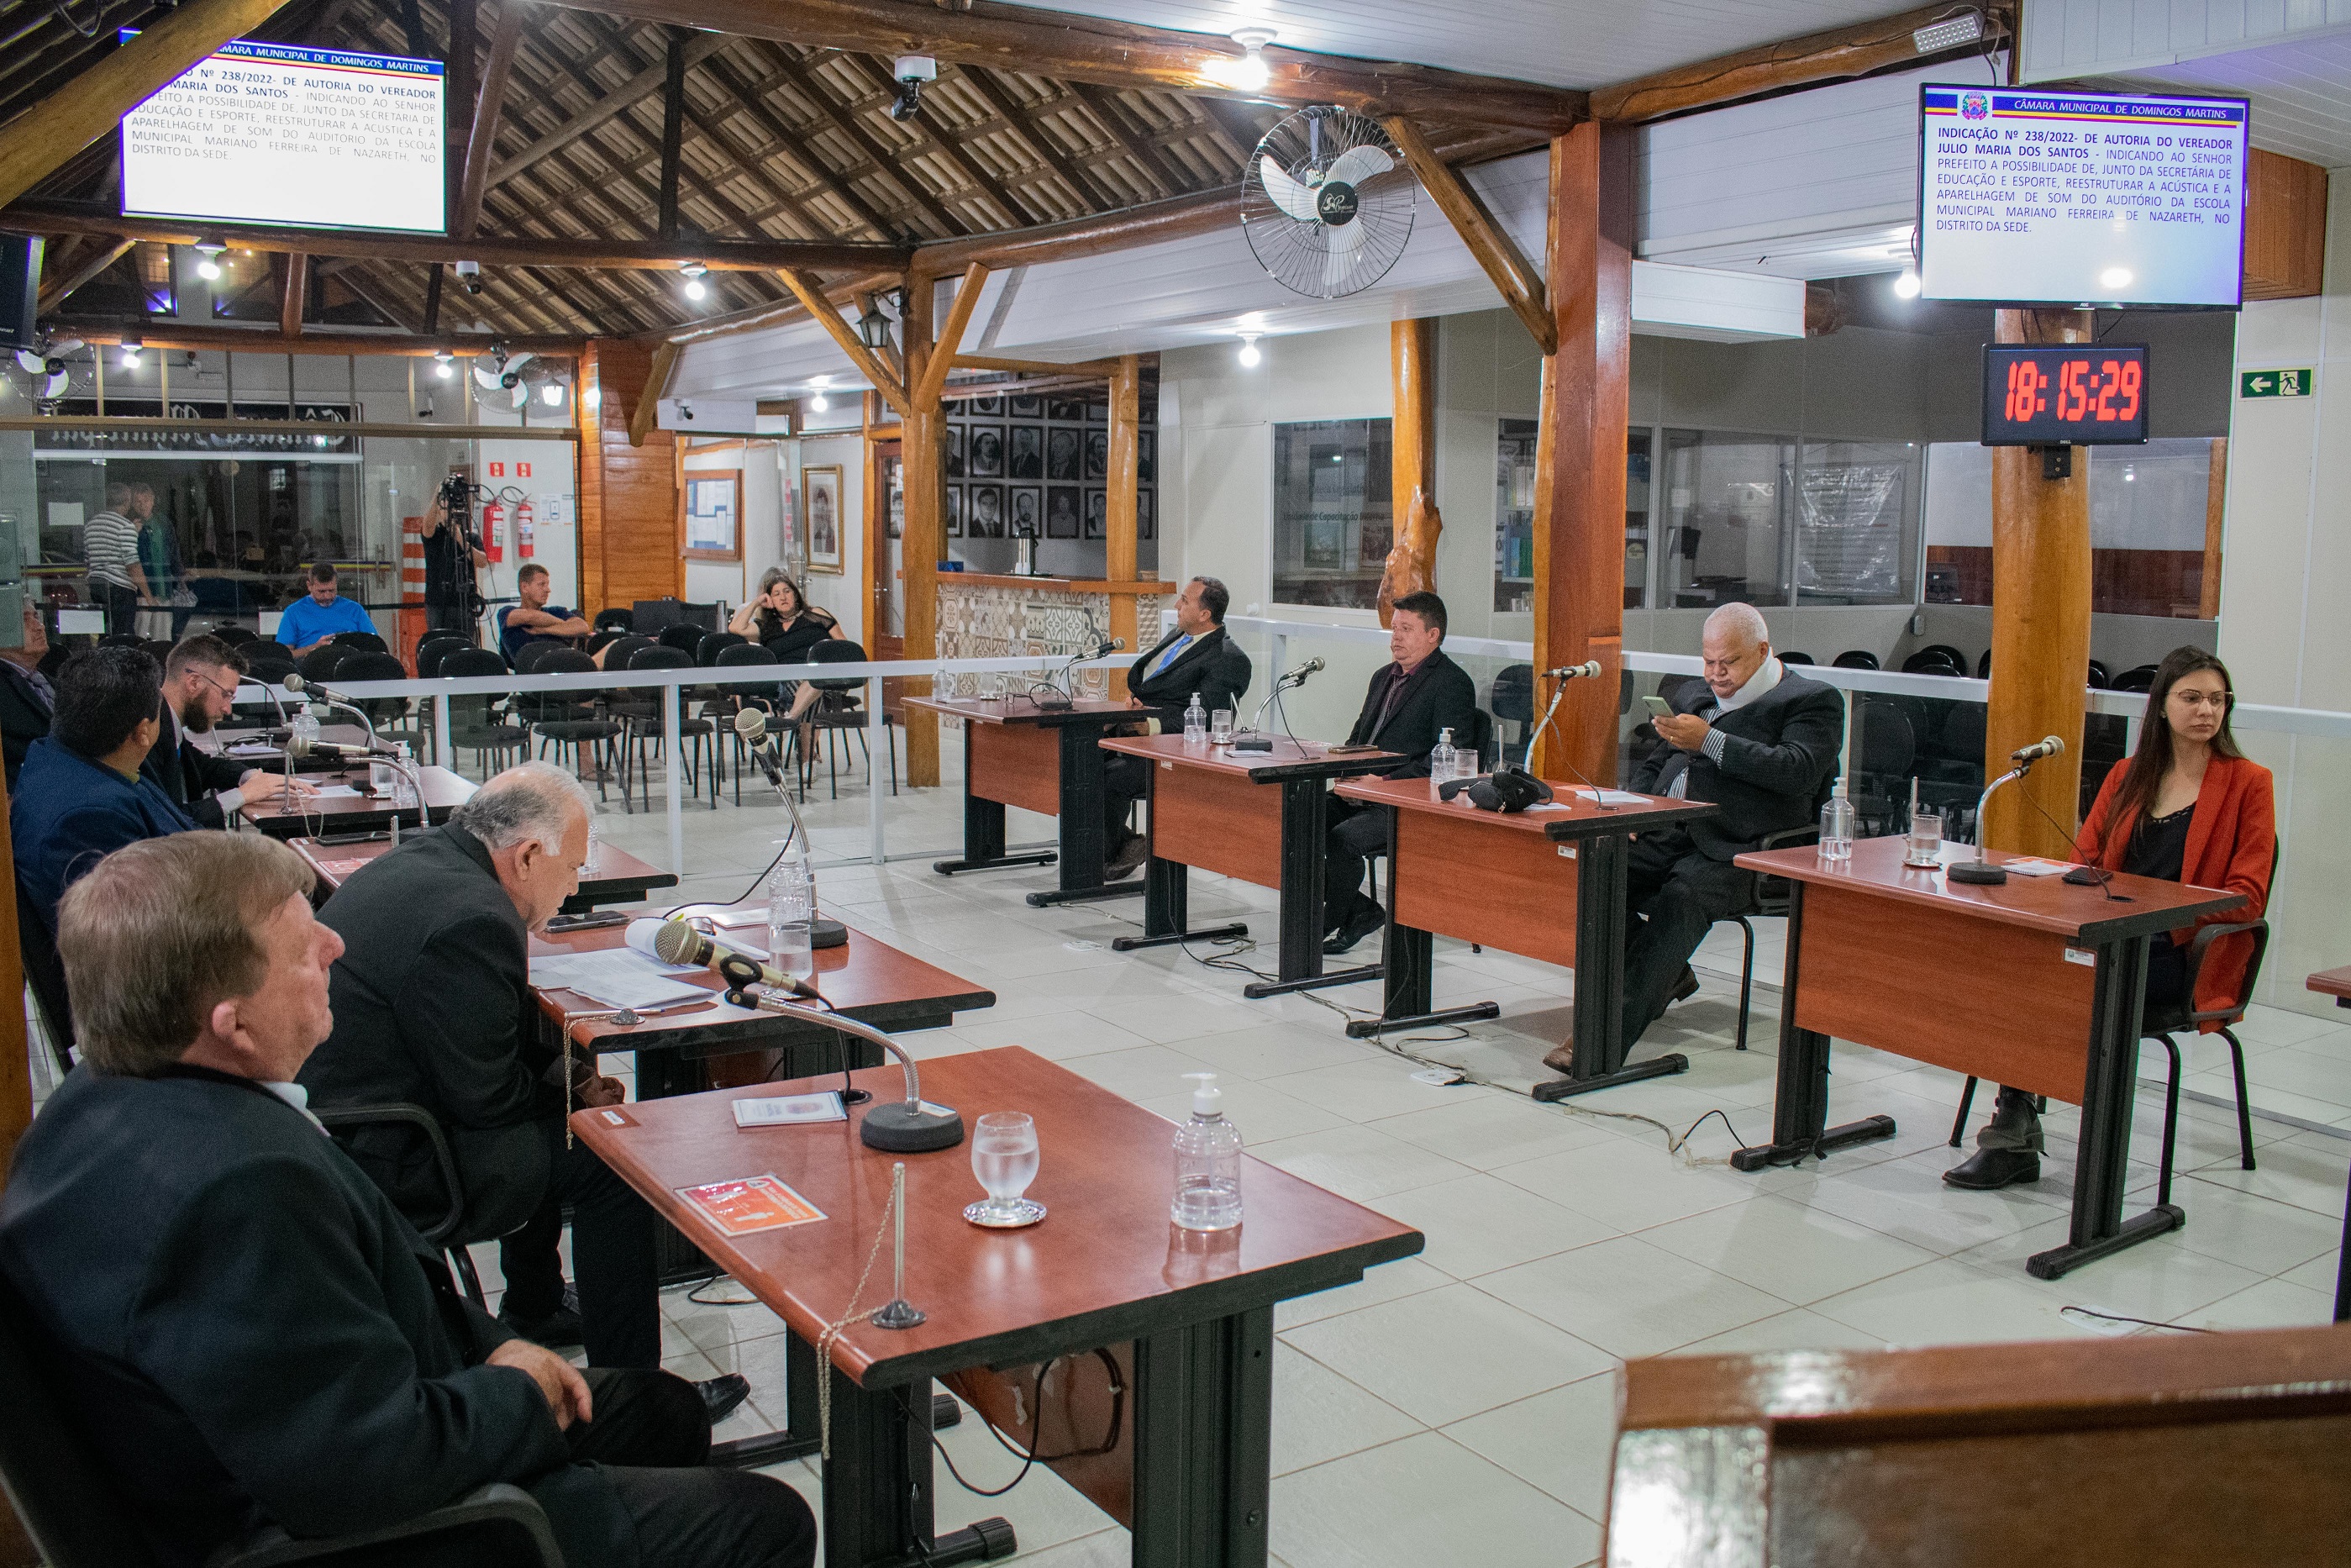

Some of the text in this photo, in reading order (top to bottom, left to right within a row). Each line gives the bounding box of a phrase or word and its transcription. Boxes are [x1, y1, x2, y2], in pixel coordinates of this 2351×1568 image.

[219, 45, 429, 73] MARA MUNICIPAL DE DOMINGOS MARTINS
[170, 81, 208, 91] MARIA
[215, 84, 239, 94] DOS
[245, 86, 288, 98] SANTOS
[306, 92, 366, 106] INDICANDO
[373, 98, 388, 108] AO
[395, 100, 435, 112] SENHOR
[283, 76, 297, 86] DE
[304, 79, 351, 91] AUTORIA
[359, 83, 374, 93] DO
[381, 86, 436, 99] VEREADOR
[187, 94, 194, 103] A
[199, 95, 276, 111] POSSIBILIDADE
[303, 105, 337, 116] JUNTO
[342, 108, 355, 117] DA
[423, 115, 435, 124] DE
[2014, 98, 2227, 119] CÂMARA MUNICIPAL DE DOMINGOS MARTINS
[198, 108, 203, 118] E
[266, 114, 345, 129] REESTRUTURAR
[351, 122, 359, 130] A
[418, 128, 423, 136] E
[132, 117, 213, 132] APARELHAGEM
[224, 124, 237, 134] DE
[247, 126, 272, 136] SOM
[282, 129, 298, 139] DO
[375, 137, 389, 146] DA
[398, 139, 436, 150] ESCOLA
[1938, 127, 1998, 141] INDICAÇÃO
[2085, 134, 2098, 144] DE
[2104, 134, 2150, 145] AUTORIA
[2157, 137, 2172, 147] DO
[2179, 138, 2233, 150] VEREADOR
[132, 130, 193, 144] MUNICIPAL
[205, 136, 257, 149] MARIANO
[269, 141, 318, 153] FERREIRA
[329, 146, 341, 155] DE
[420, 154, 435, 163] NO
[132, 144, 181, 156] DISTRITO
[184, 148, 199, 157] DA
[1938, 143, 1968, 154] JULIO
[1975, 144, 2012, 155] MARIA
[2018, 146, 2041, 156] DOS
[2048, 147, 2089, 159] SANTOS
[2106, 150, 2164, 161] INDICANDO
[2170, 152, 2185, 162] AO
[2191, 153, 2233, 164] SENHOR
[1938, 158, 1986, 170] PREFEITO
[1991, 160, 1998, 170] A
[2002, 160, 2077, 173] POSSIBILIDADE
[2101, 165, 2135, 176] JUNTO
[2139, 166, 2154, 176] DA
[2218, 169, 2232, 179] DE
[1938, 173, 1996, 187] EDUCAÇÃO
[2001, 176, 2007, 186] E
[2065, 177, 2143, 191] REESTRUTURAR
[2148, 182, 2155, 191] A
[2160, 179, 2208, 193] ACÚSTICA
[2213, 183, 2219, 193] E
[2224, 184, 2231, 194] A
[1937, 189, 2231, 208] APARELHAGEM DE SOM DO AUDITÓRIO DA ESCOLA
[1937, 204, 1995, 216] MUNICIPAL
[2006, 207, 2057, 218] MARIANO
[2068, 208, 2115, 220] FERREIRA
[2126, 210, 2138, 220] DE
[2214, 213, 2230, 224] NO
[1936, 219, 2032, 233] DISTRITO DA SEDE.
